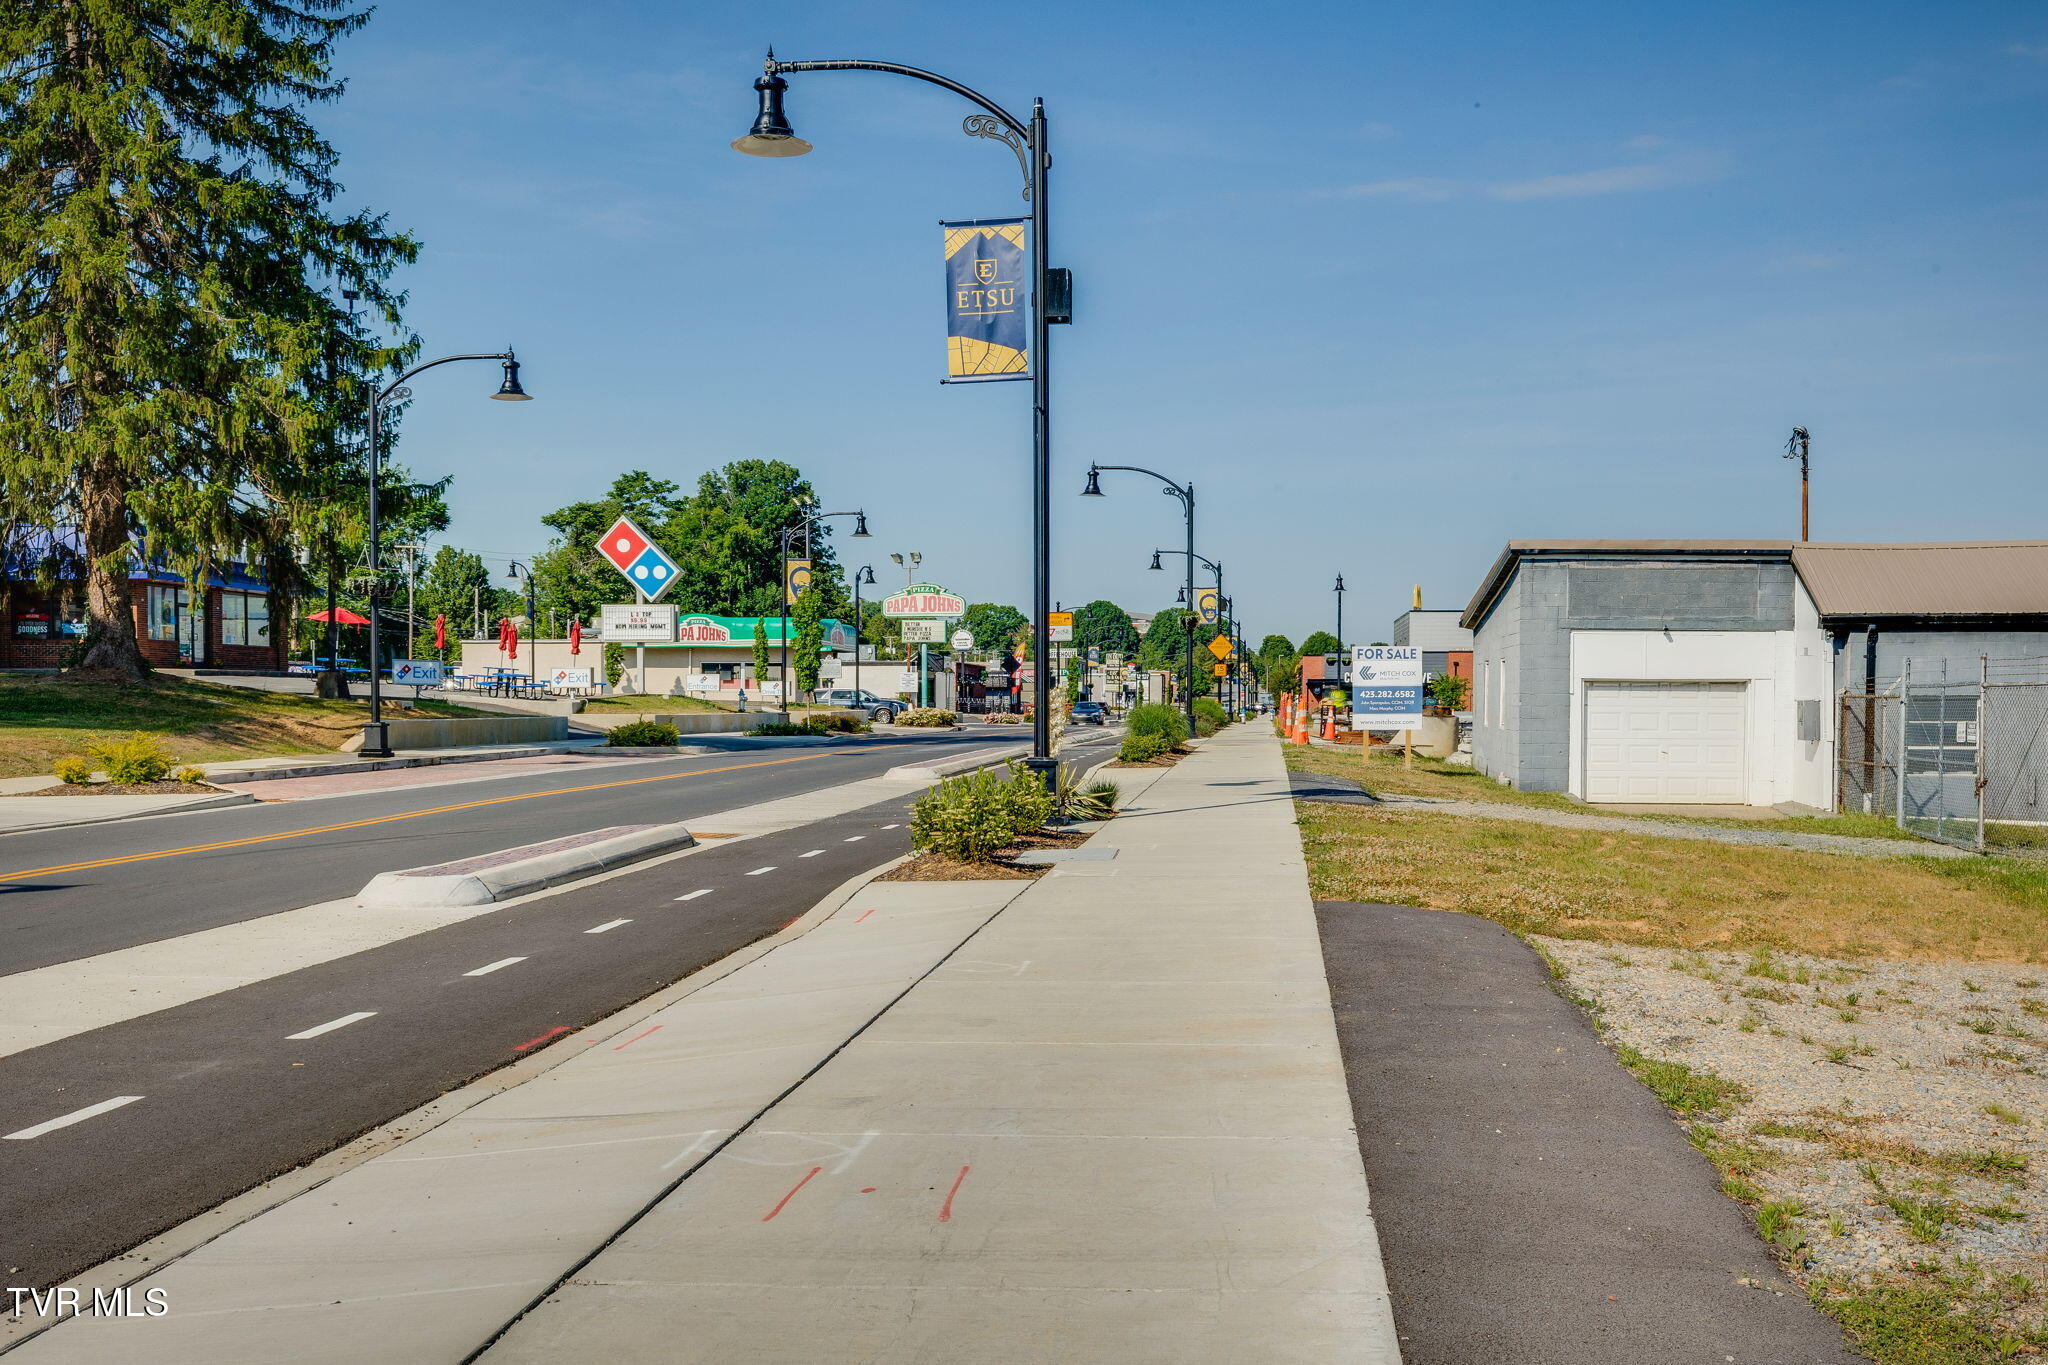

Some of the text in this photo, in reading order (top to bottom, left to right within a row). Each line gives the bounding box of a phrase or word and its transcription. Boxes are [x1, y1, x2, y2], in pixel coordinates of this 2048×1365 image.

[956, 288, 1015, 308] ETSU
[886, 596, 961, 613] PAPA JOHNS
[696, 626, 727, 641] JOHNS
[1357, 648, 1417, 659] FOR SALE
[413, 666, 438, 679] Exit
[568, 672, 589, 683] Exit
[688, 682, 718, 690] Entrance
[1360, 690, 1416, 698] 423.282.6582
